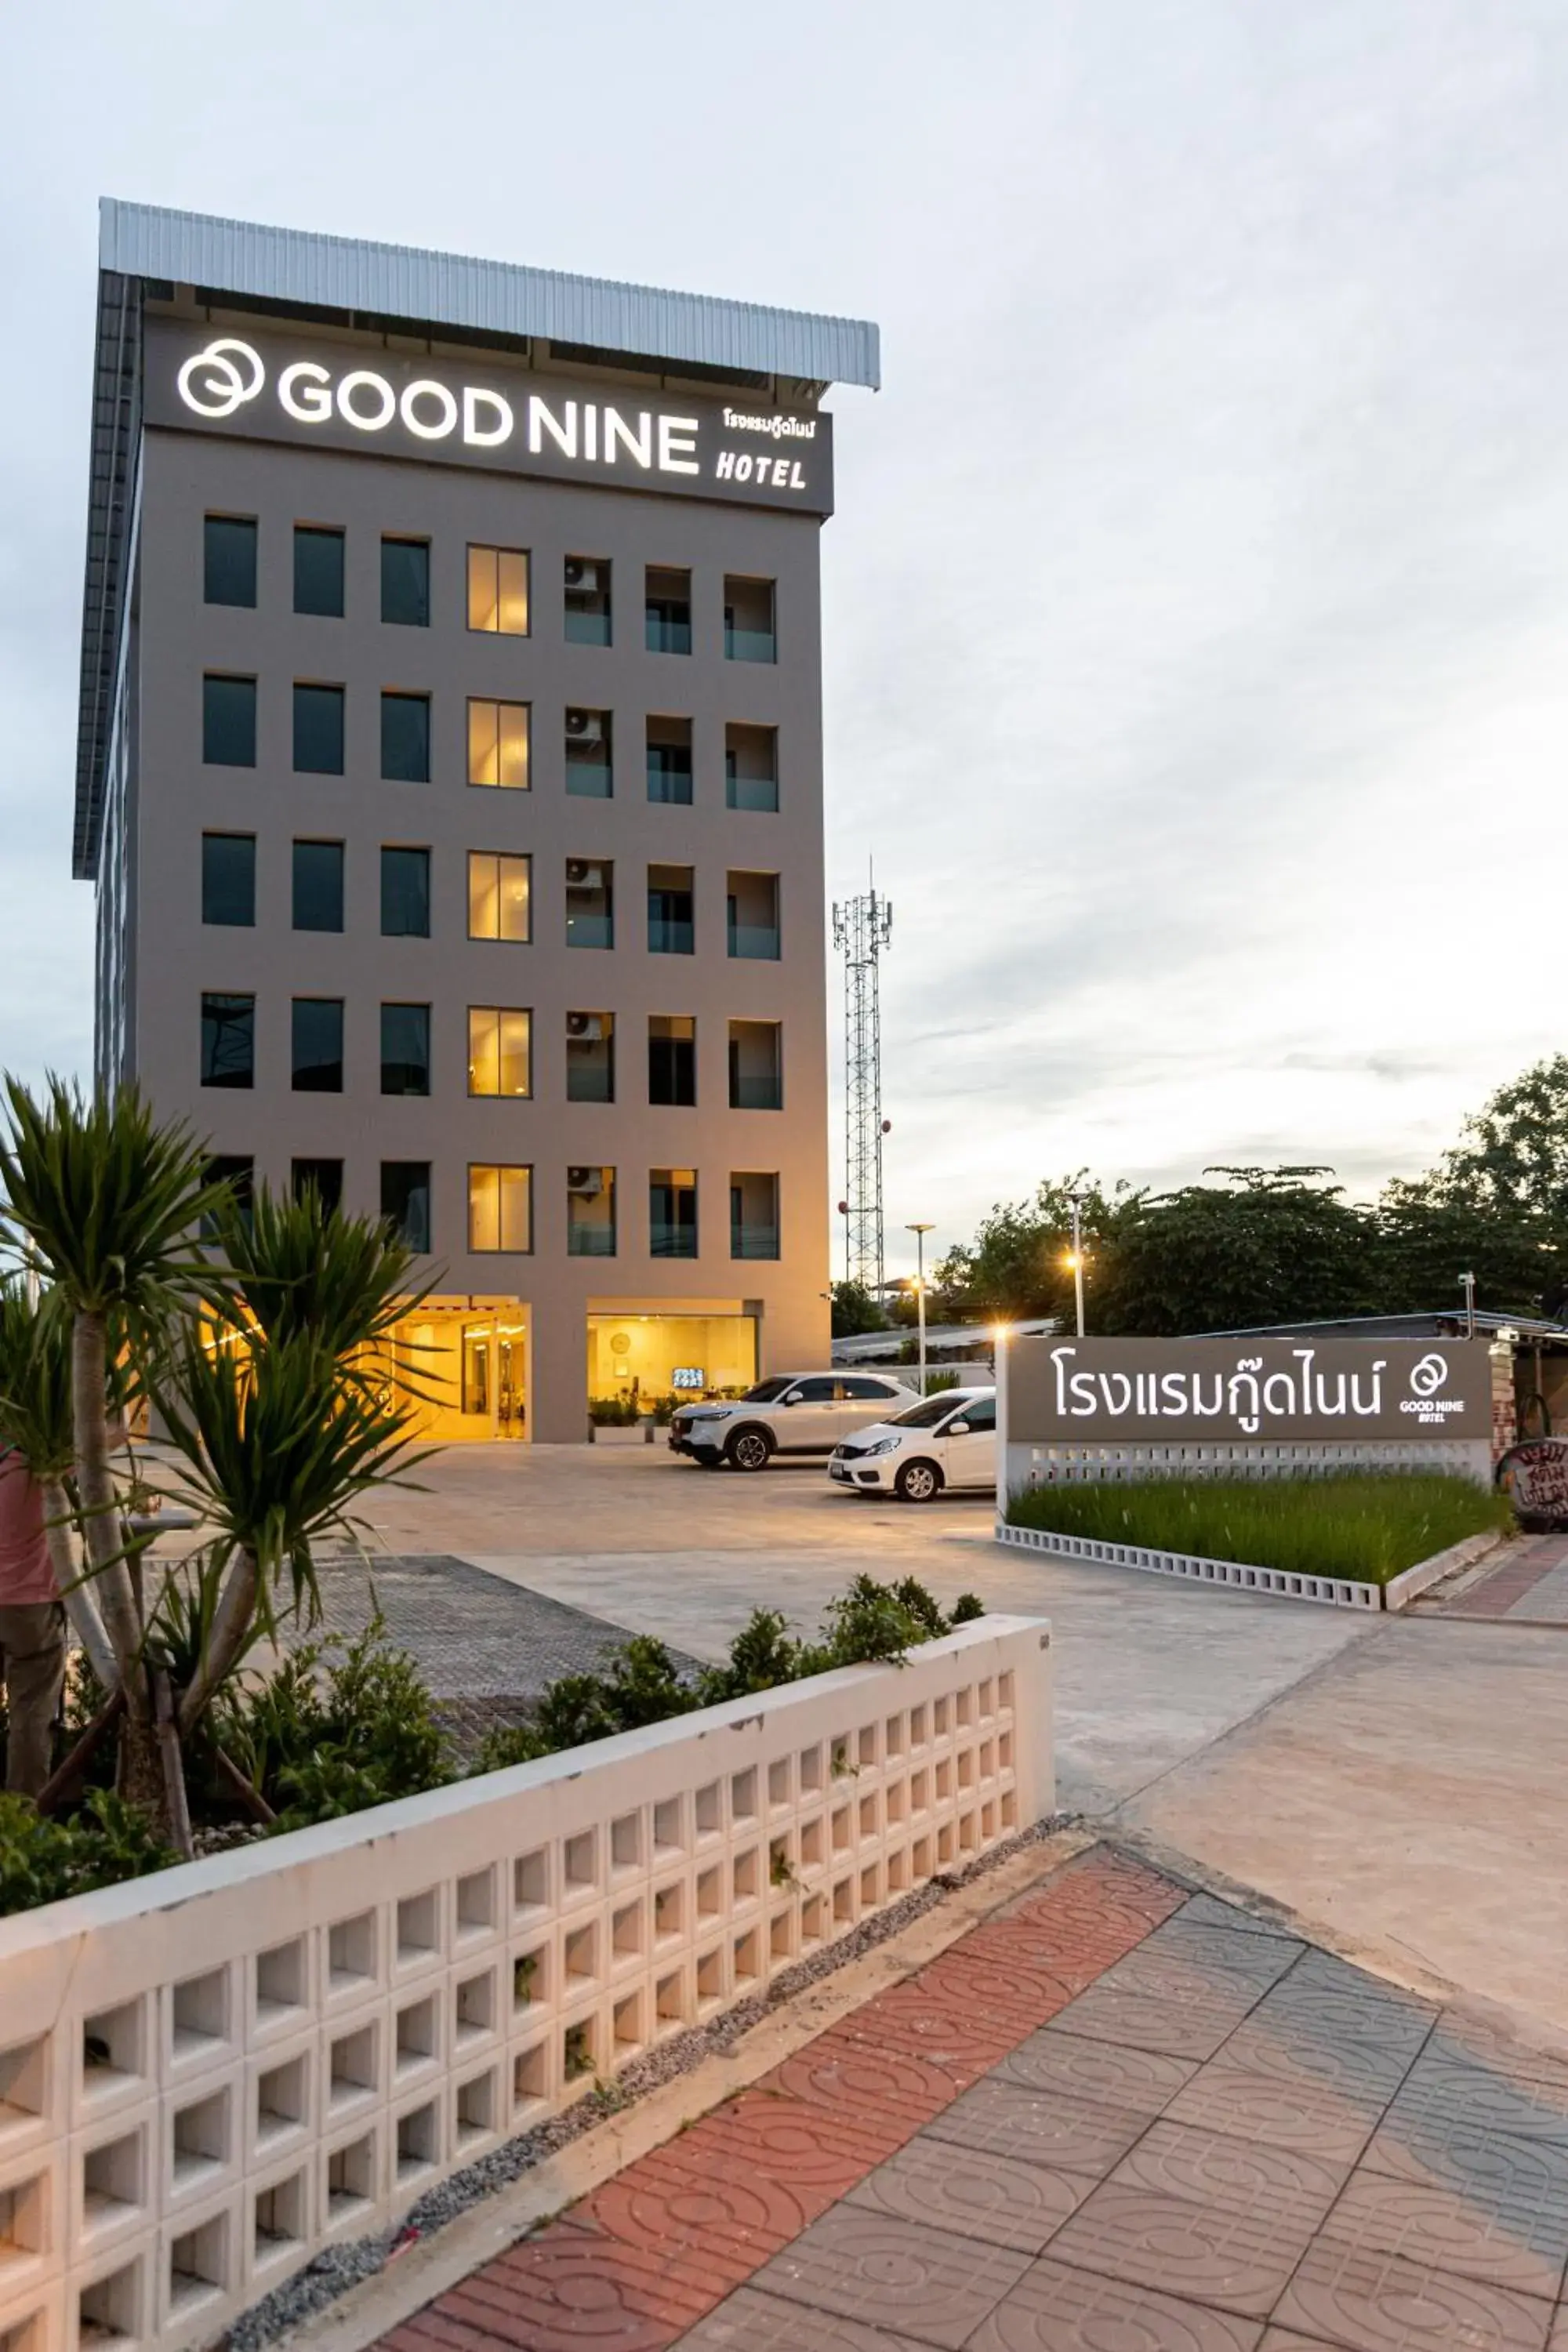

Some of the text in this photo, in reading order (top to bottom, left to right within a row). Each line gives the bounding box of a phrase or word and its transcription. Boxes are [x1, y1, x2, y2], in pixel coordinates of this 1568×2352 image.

[278, 361, 699, 474] GOOD NINE
[716, 452, 807, 489] HOTEL
[1050, 1347, 1387, 1433] โรงแรมกู๊ดไนน์
[1399, 1400, 1465, 1412] GOOD NINE
